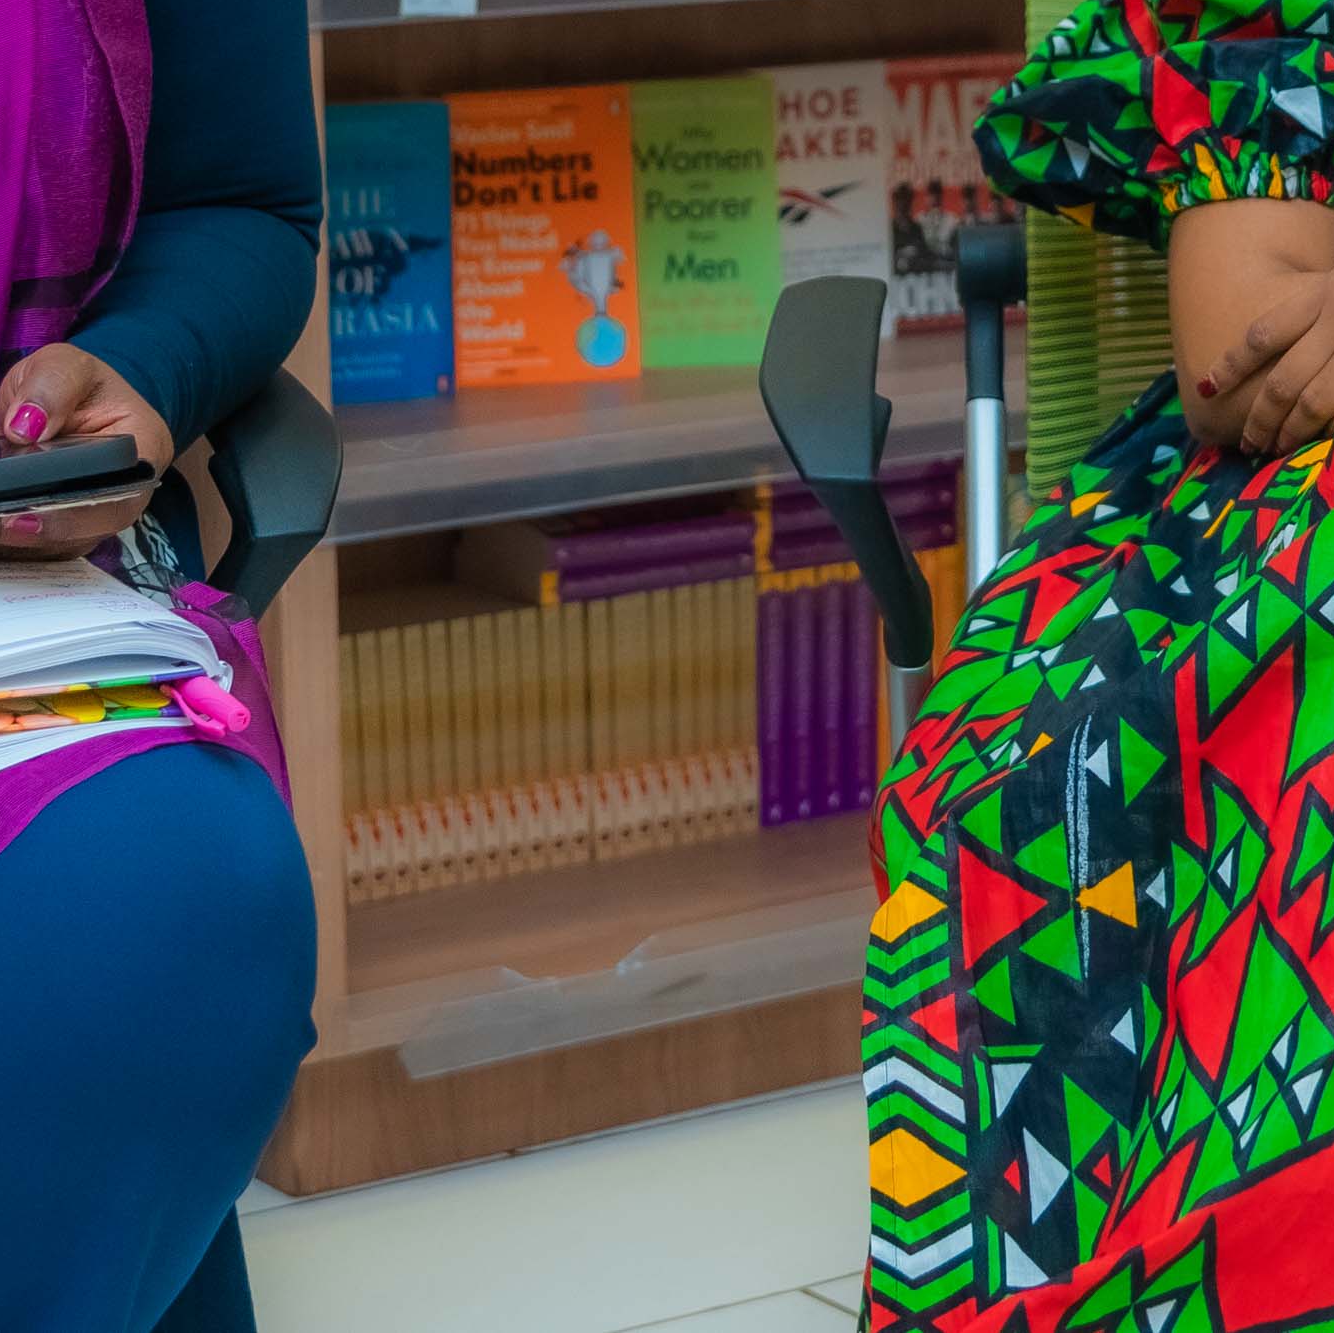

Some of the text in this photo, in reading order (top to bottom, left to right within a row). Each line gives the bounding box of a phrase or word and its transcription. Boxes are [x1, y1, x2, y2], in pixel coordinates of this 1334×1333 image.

[777, 85, 862, 120] HOE
[633, 143, 766, 174] Women
[776, 126, 879, 161] AKER
[452, 145, 595, 177] Numbers
[453, 174, 600, 207] Don't Lie
[645, 189, 755, 224] Poorer
[331, 224, 409, 260] AWN
[336, 265, 383, 296] OF
[663, 251, 740, 284] Men
[331, 302, 441, 337] RASIA
